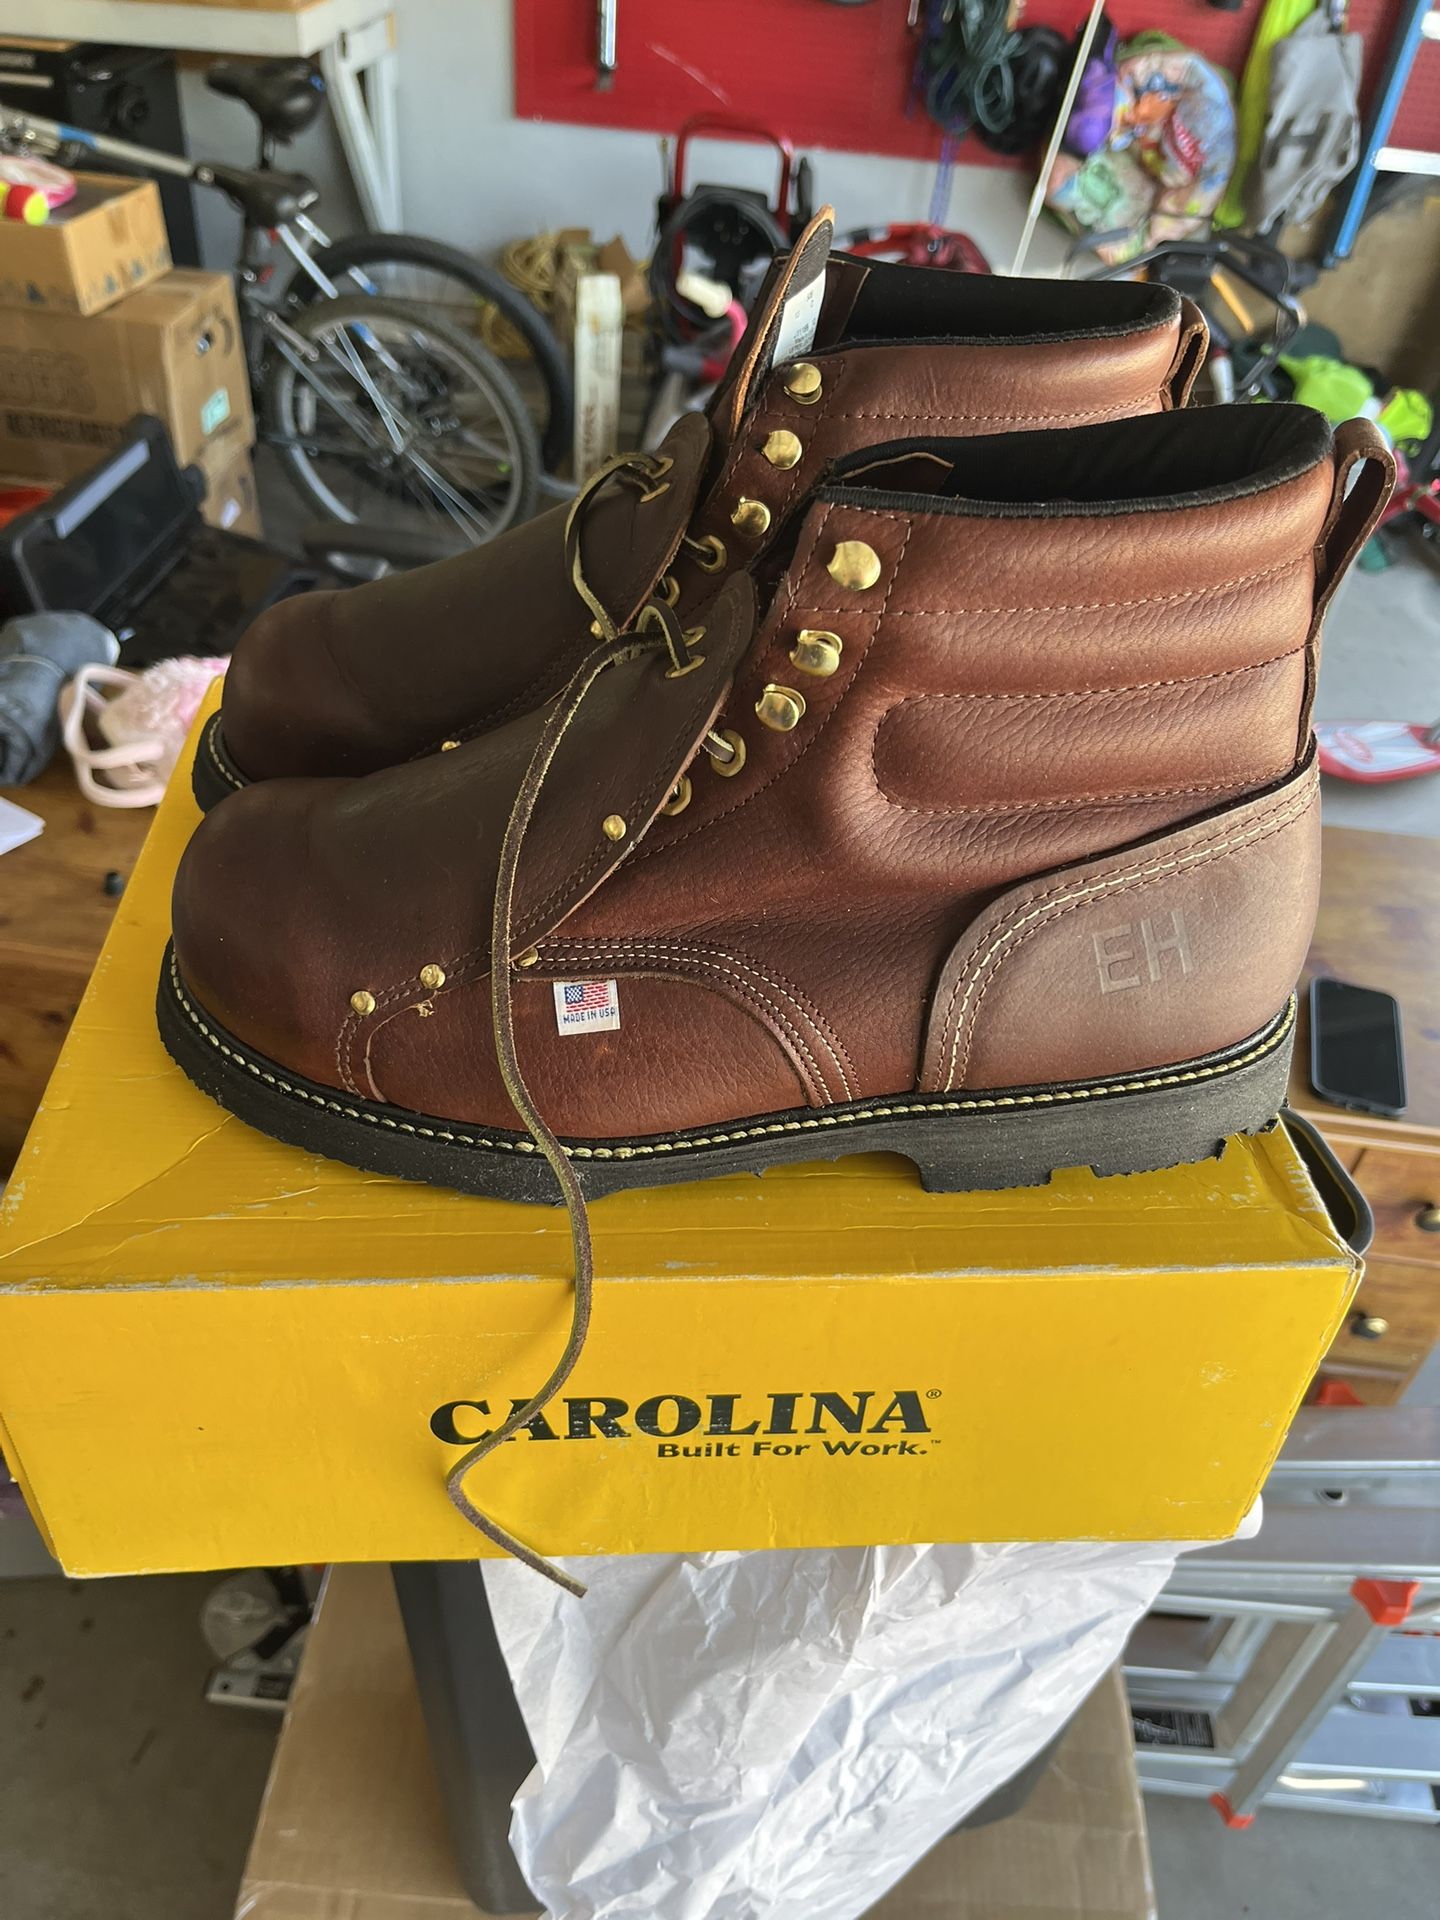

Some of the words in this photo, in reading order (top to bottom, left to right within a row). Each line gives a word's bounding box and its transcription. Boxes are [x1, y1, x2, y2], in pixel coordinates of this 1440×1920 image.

[1092, 911, 1193, 994] EH
[563, 1012, 585, 1024] MADE
[587, 1009, 597, 1020] IN
[599, 1006, 616, 1018] USA
[657, 1442, 741, 1458] Built
[752, 1441, 811, 1456] For
